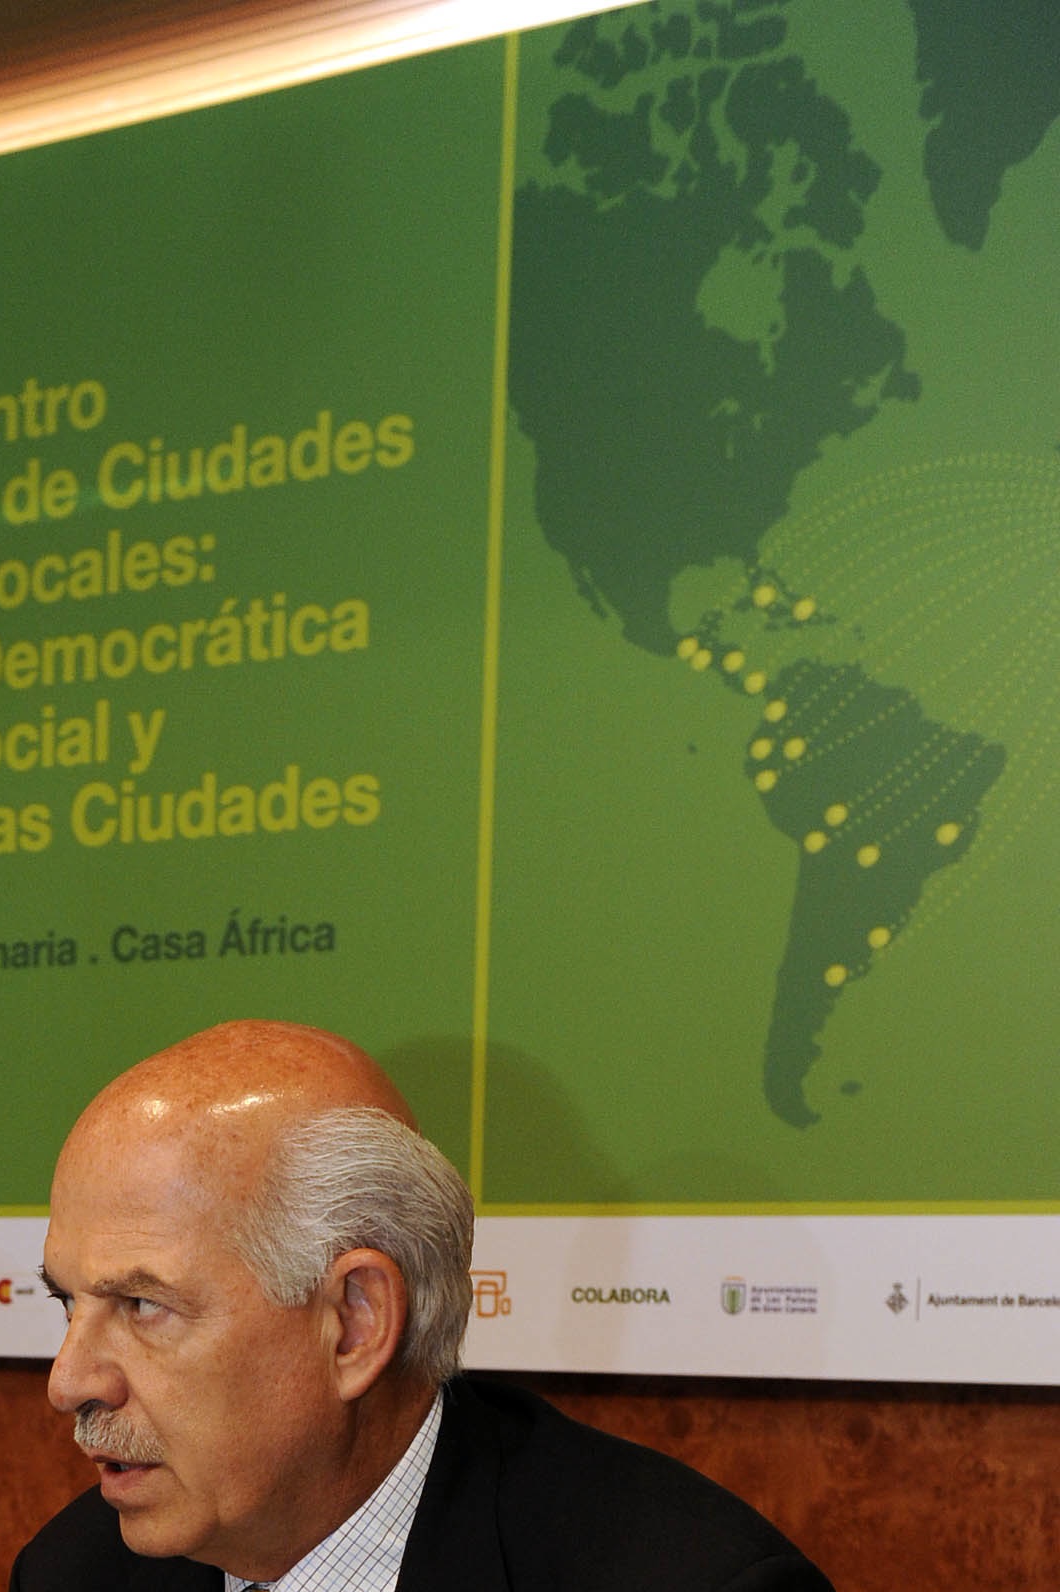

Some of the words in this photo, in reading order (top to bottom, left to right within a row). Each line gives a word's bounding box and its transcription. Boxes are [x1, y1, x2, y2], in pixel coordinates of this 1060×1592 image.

[2, 459, 79, 525] de
[98, 409, 414, 509] Ciudades
[127, 708, 165, 774] y
[71, 764, 381, 847] Ciudades
[111, 924, 206, 962] Casa
[219, 908, 335, 957] África
[571, 1287, 670, 1303] COLABORA
